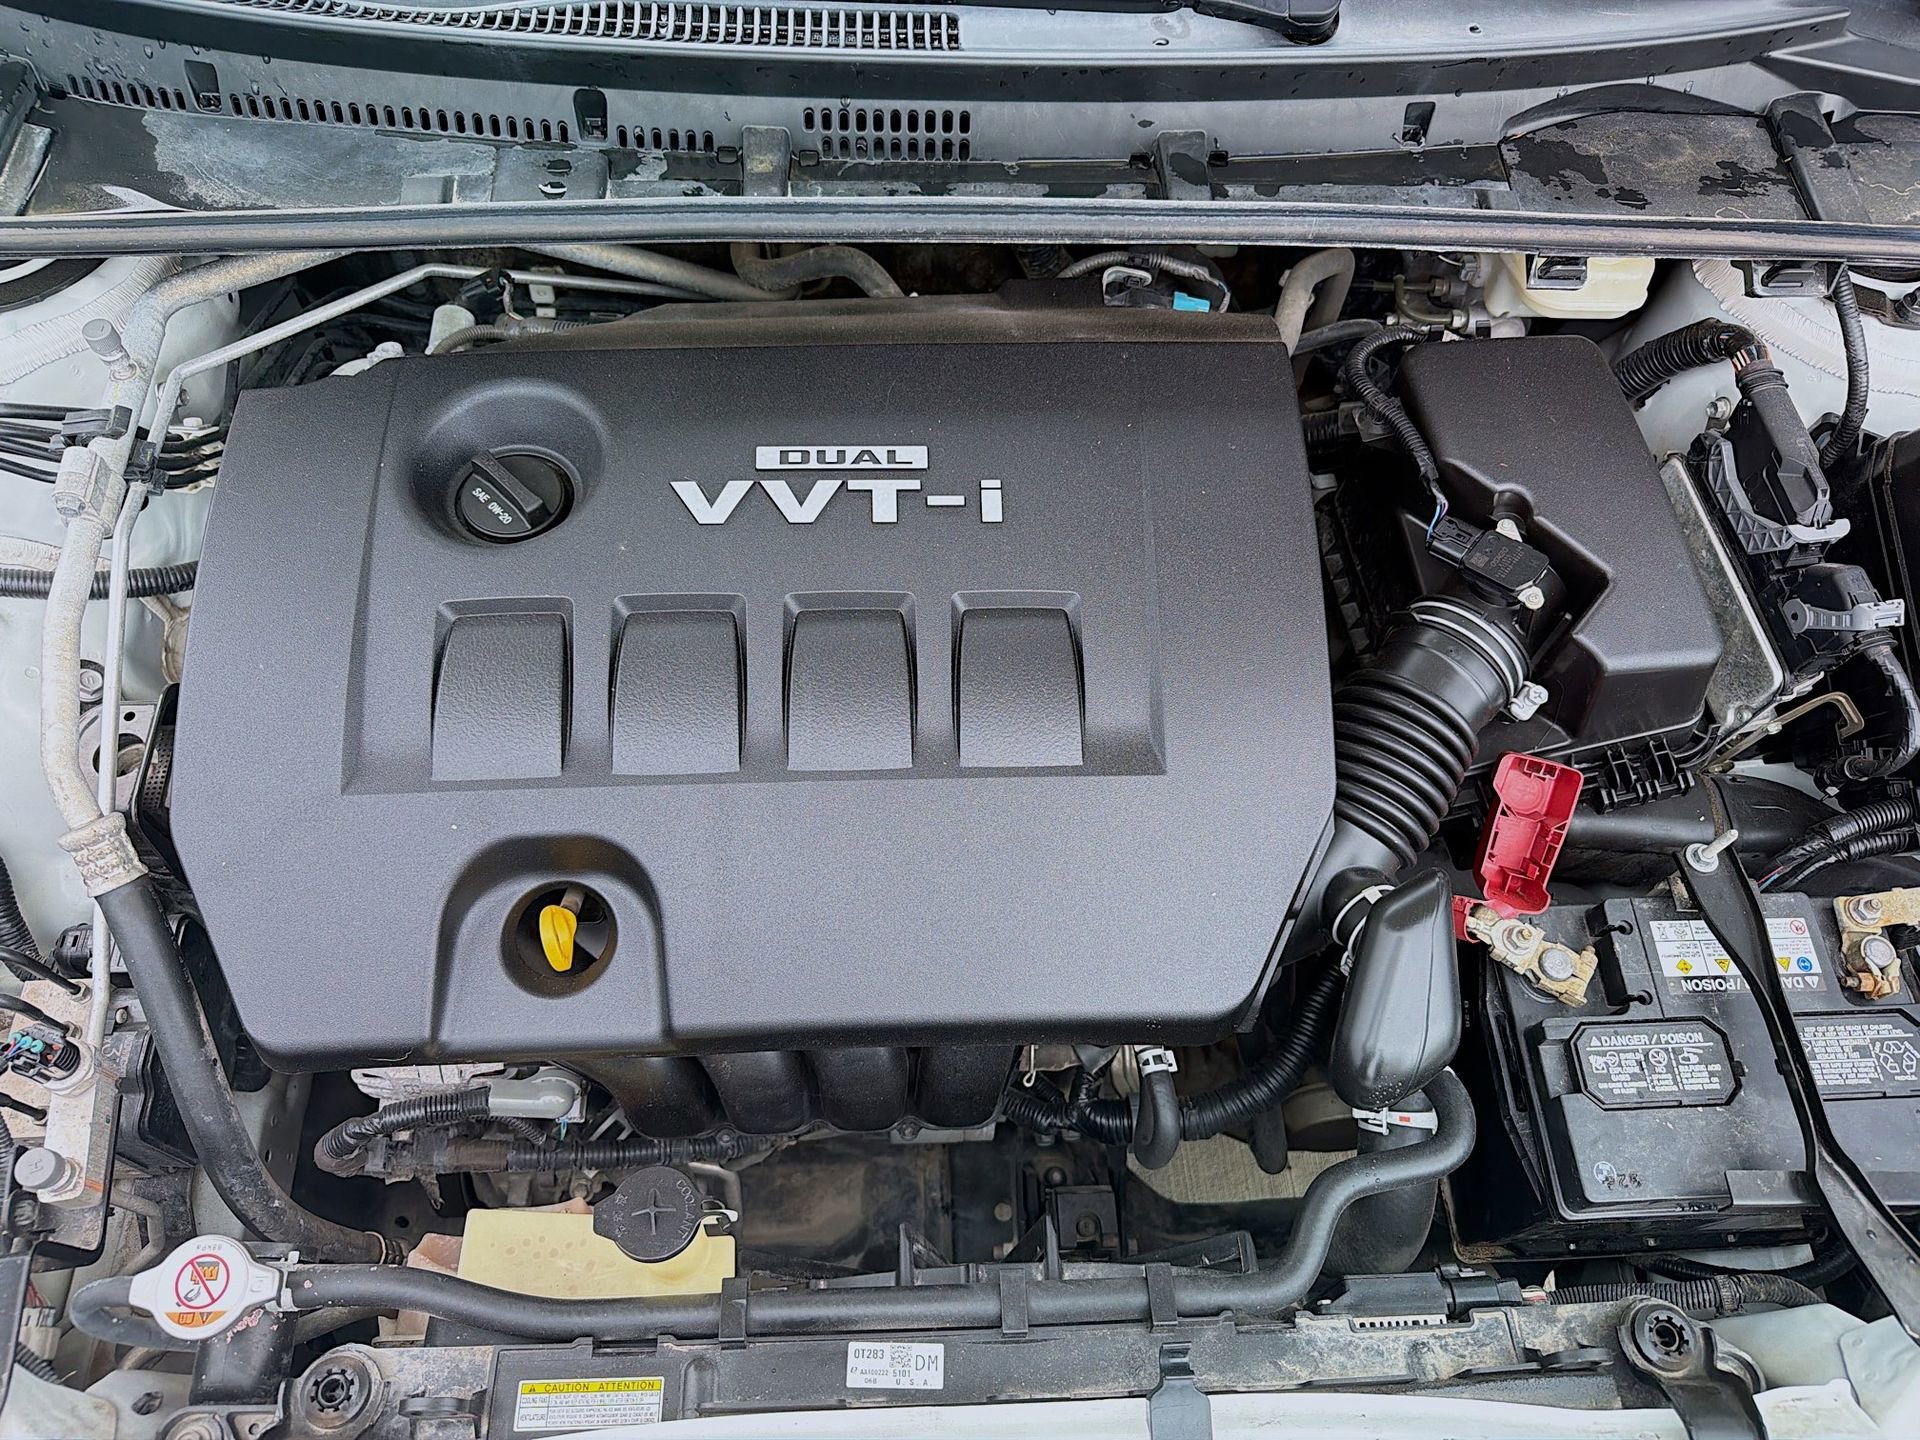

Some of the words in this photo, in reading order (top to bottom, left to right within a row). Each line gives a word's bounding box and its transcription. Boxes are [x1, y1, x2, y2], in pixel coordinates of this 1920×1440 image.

[779, 449, 913, 465] DUAL
[471, 487, 491, 504] SAE
[669, 479, 1004, 525] VVT-i
[1681, 978, 1737, 992] POISON
[1600, 1035, 1649, 1046] DANGER
[1651, 1034, 1658, 1045] /
[1660, 1032, 1704, 1044] POISON
[676, 1179, 696, 1239] COOLANT
[915, 1354, 938, 1372] DM
[544, 1382, 590, 1392] CAUTION
[598, 1380, 655, 1390] ATTENTION
